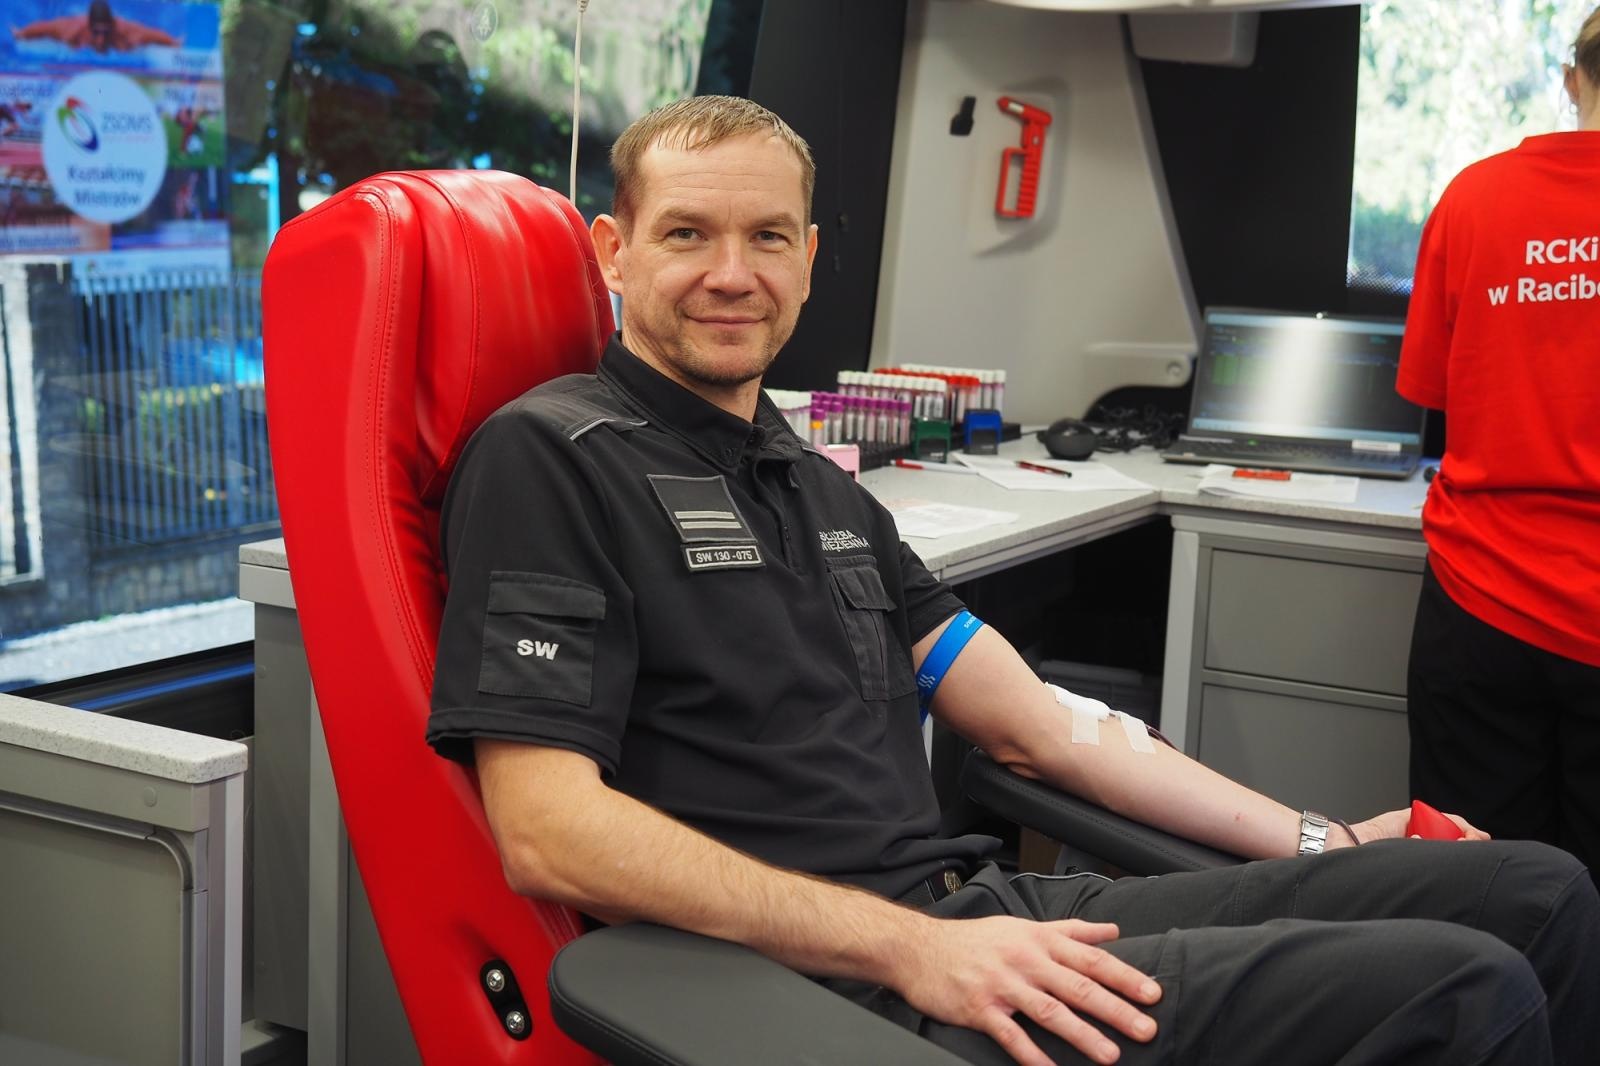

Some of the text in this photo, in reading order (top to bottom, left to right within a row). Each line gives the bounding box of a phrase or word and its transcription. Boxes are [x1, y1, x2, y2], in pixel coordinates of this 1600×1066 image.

[1487, 273, 1600, 306] w Racib
[695, 551, 712, 563] SW
[713, 550, 731, 561] 130
[516, 639, 559, 661] SW
